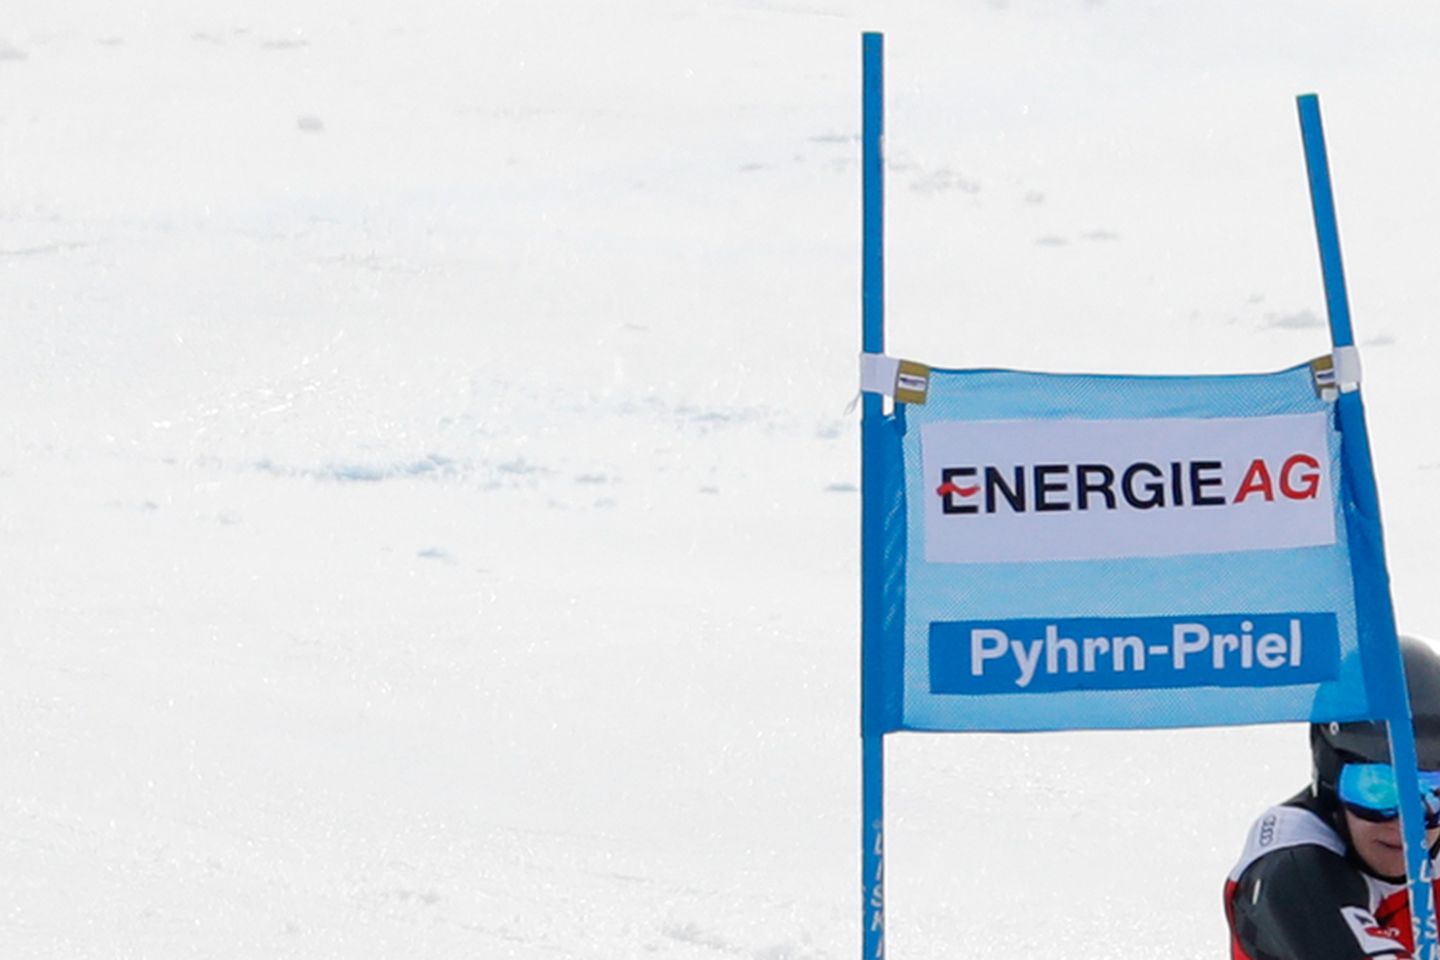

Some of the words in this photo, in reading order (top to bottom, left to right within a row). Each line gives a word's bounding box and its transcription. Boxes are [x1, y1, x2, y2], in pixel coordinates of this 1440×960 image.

[937, 460, 1228, 516] ENERGIE
[1233, 452, 1322, 504] AG
[969, 619, 1302, 687] Pyhrn-Priel
